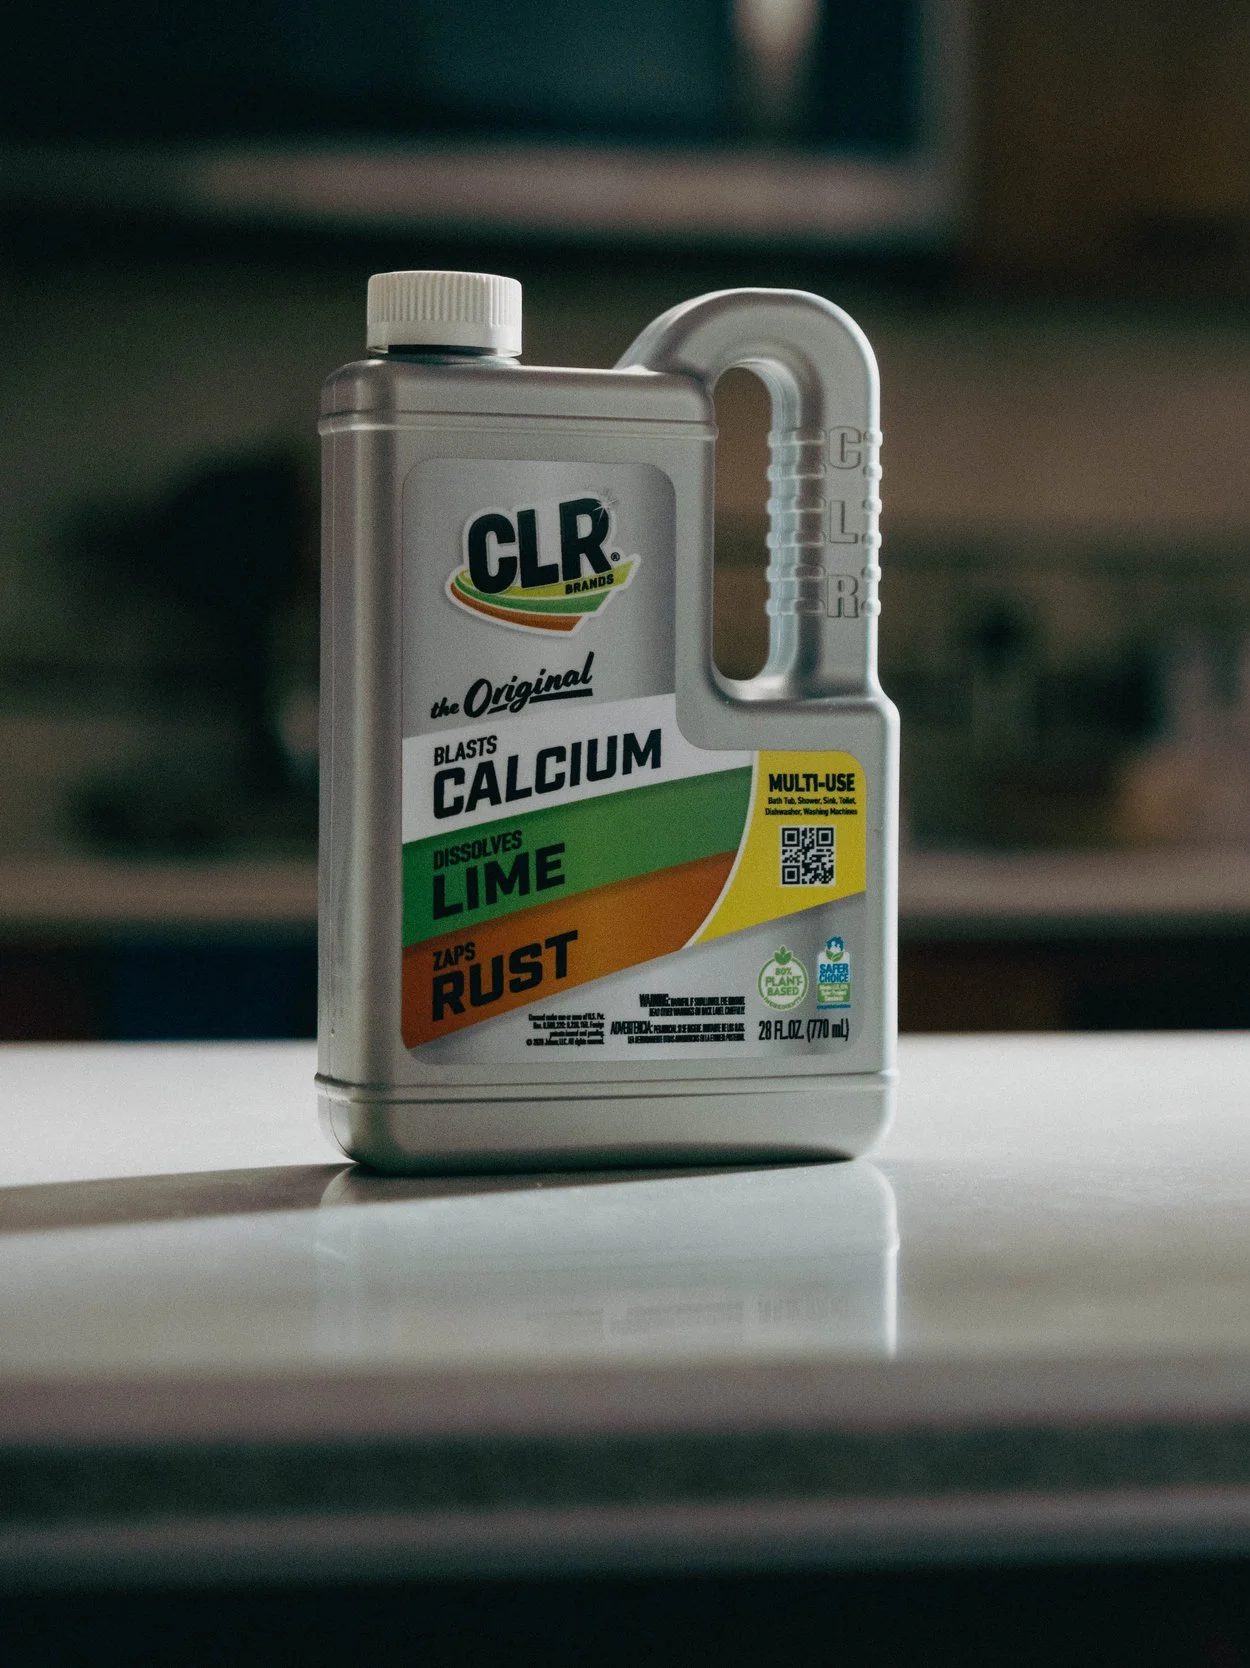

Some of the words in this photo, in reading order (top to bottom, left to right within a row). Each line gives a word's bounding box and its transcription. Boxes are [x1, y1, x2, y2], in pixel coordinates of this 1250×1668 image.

[827, 425, 862, 618] CLR
[468, 498, 612, 594] CLR
[565, 574, 614, 594] BRANDS
[430, 697, 460, 719] the
[463, 651, 594, 718] Original
[433, 735, 498, 766] BLASTS
[433, 729, 662, 819] CALCIUM
[768, 773, 855, 792] MULTI-USE
[768, 796, 782, 804] Bath
[798, 796, 822, 805] Shower,
[433, 830, 522, 870] DISSOLVES
[432, 842, 565, 920] LIME
[432, 941, 476, 971] ZAPS
[820, 963, 849, 974] SAFER
[432, 930, 578, 1022] RUST
[819, 973, 849, 983] CHOICE
[767, 987, 799, 996] BASED
[758, 1020, 772, 1040] 28
[807, 1018, 829, 1043] (770
[831, 1018, 850, 1041] mL)
